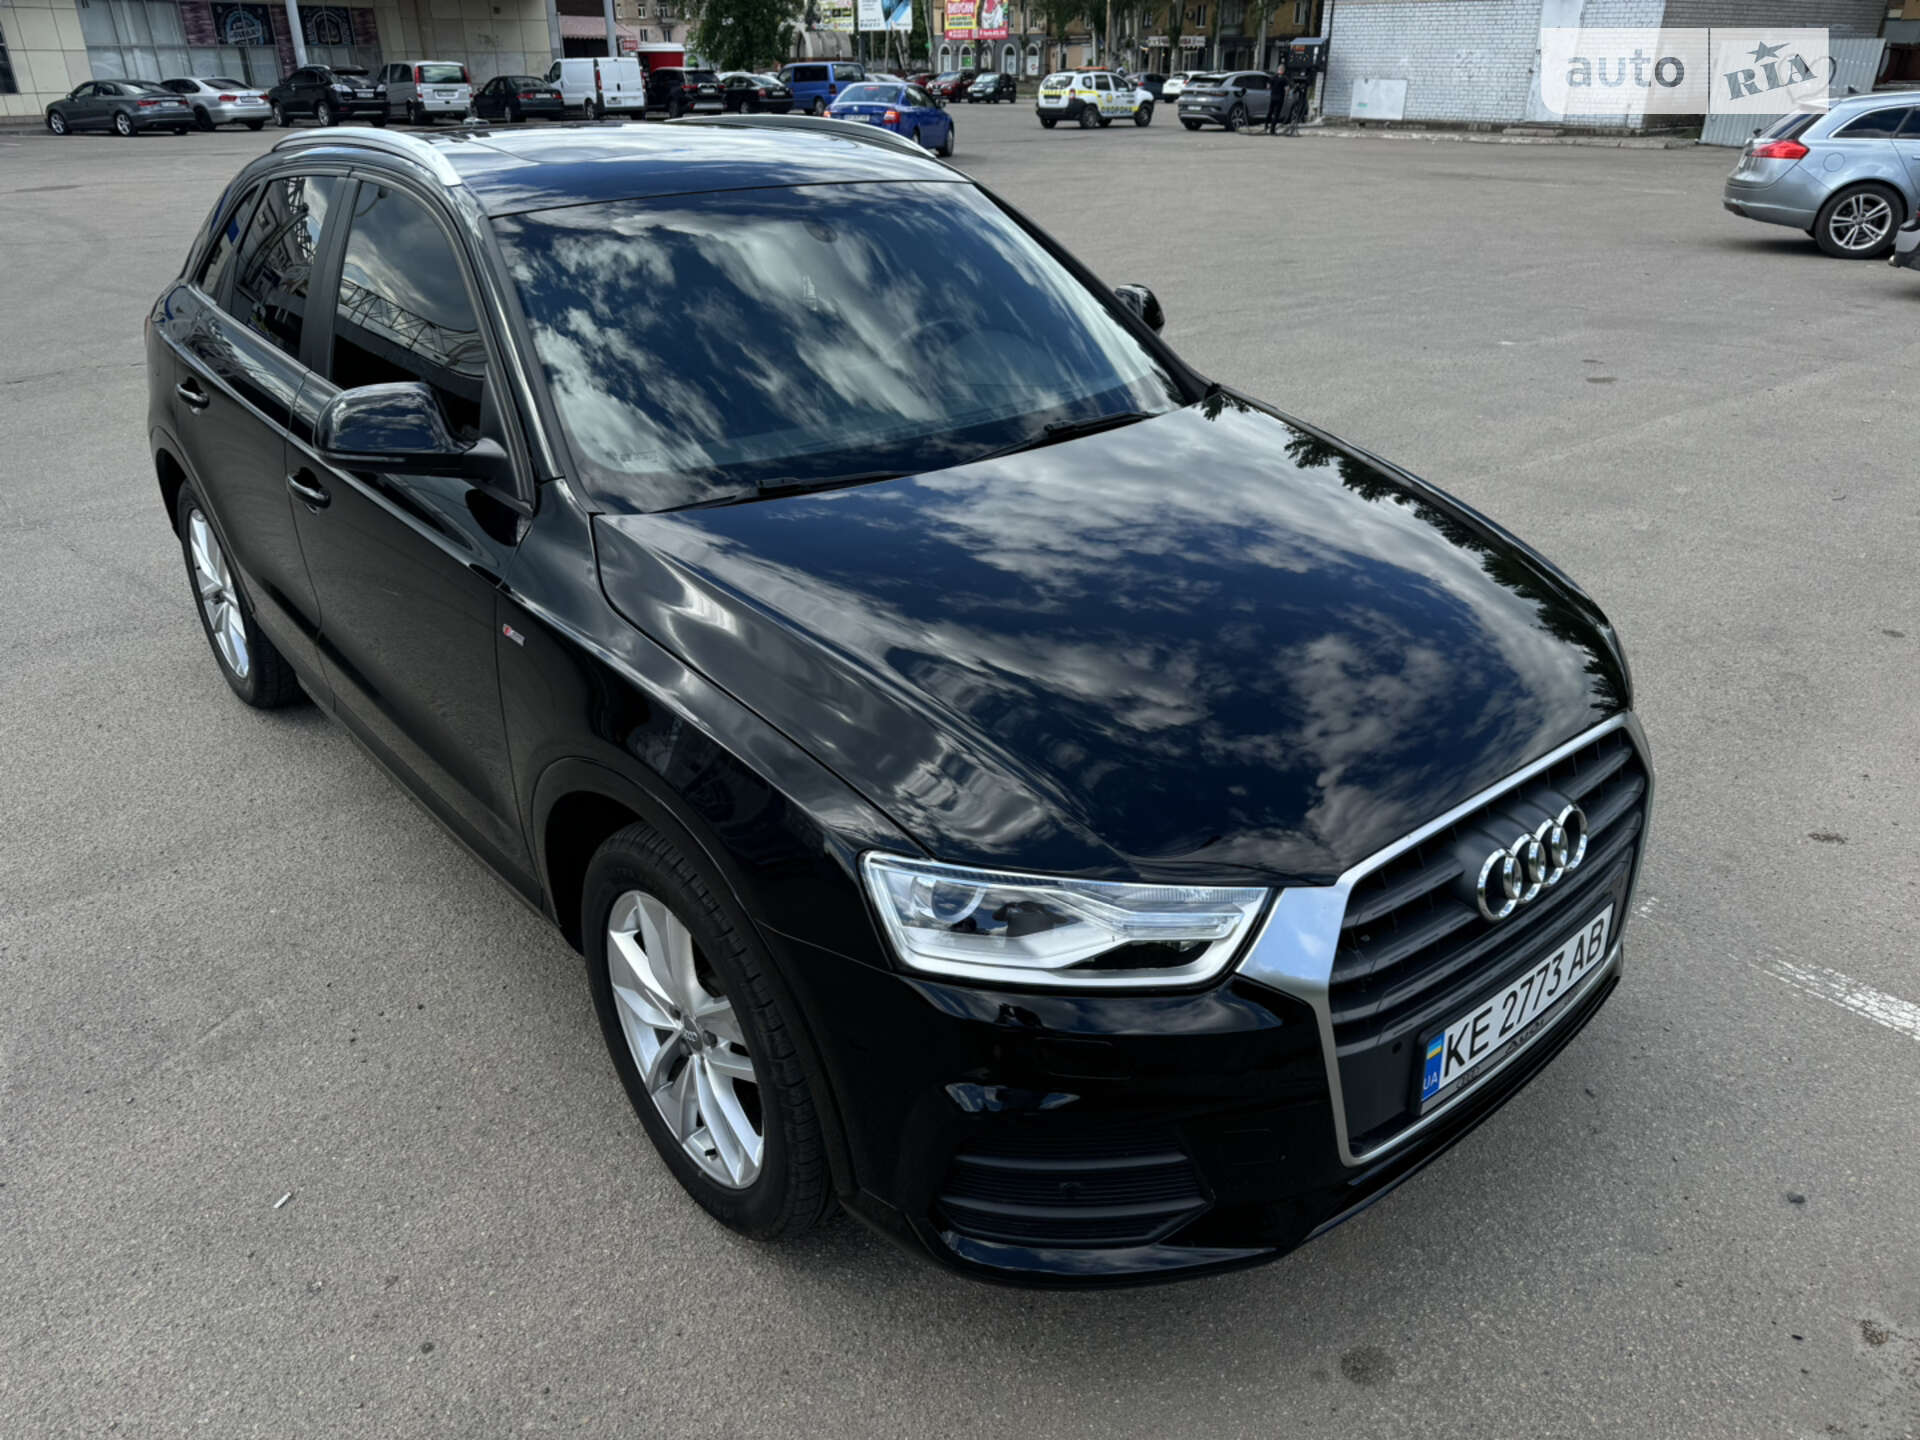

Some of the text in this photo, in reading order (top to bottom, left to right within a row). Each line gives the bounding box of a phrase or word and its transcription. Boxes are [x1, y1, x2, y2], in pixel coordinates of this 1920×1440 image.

[1444, 1006, 1493, 1078] KE
[1499, 951, 1564, 1038] 2773
[1568, 918, 1604, 981] AB
[1423, 1071, 1439, 1090] UA
